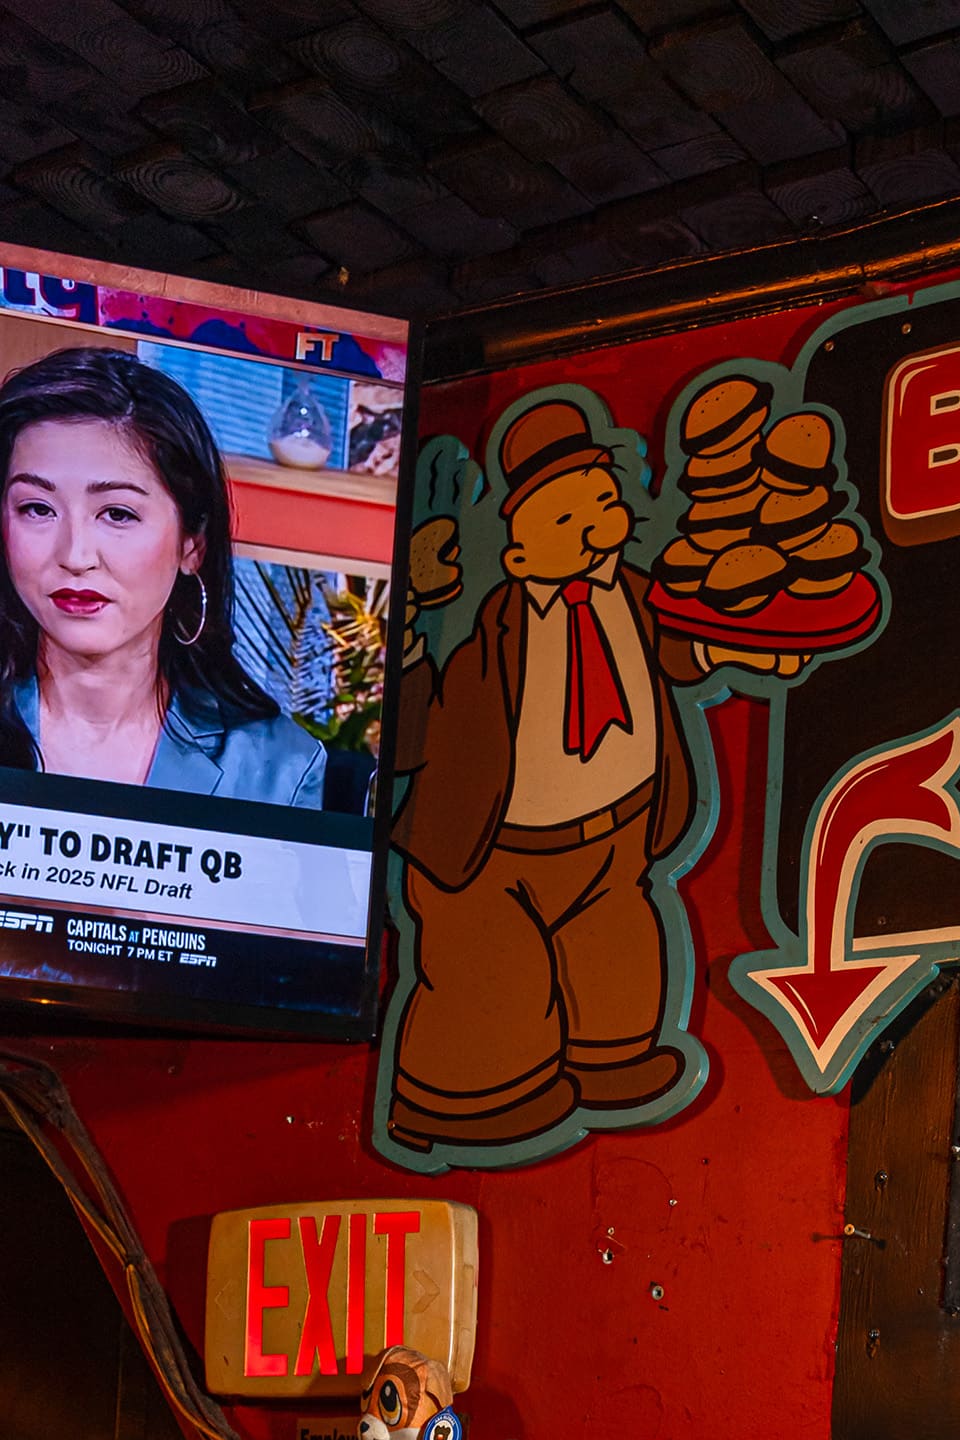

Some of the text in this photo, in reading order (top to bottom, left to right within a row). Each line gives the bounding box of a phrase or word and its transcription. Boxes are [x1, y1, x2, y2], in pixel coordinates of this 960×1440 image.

[295, 331, 340, 361] FT
[40, 827, 82, 858] TO
[91, 834, 193, 873] DRAFT
[201, 849, 243, 884] QB
[21, 863, 40, 880] in
[46, 867, 96, 887] 2025
[100, 873, 139, 893] NFL
[144, 879, 193, 899] Draft
[67, 918, 127, 942] CAPITALS
[128, 931, 140, 943] AT
[142, 927, 206, 951] PENGUINS
[67, 939, 217, 967] TONIGHT 7 PM ET ESPN
[244, 1211, 420, 1377] EXIT
